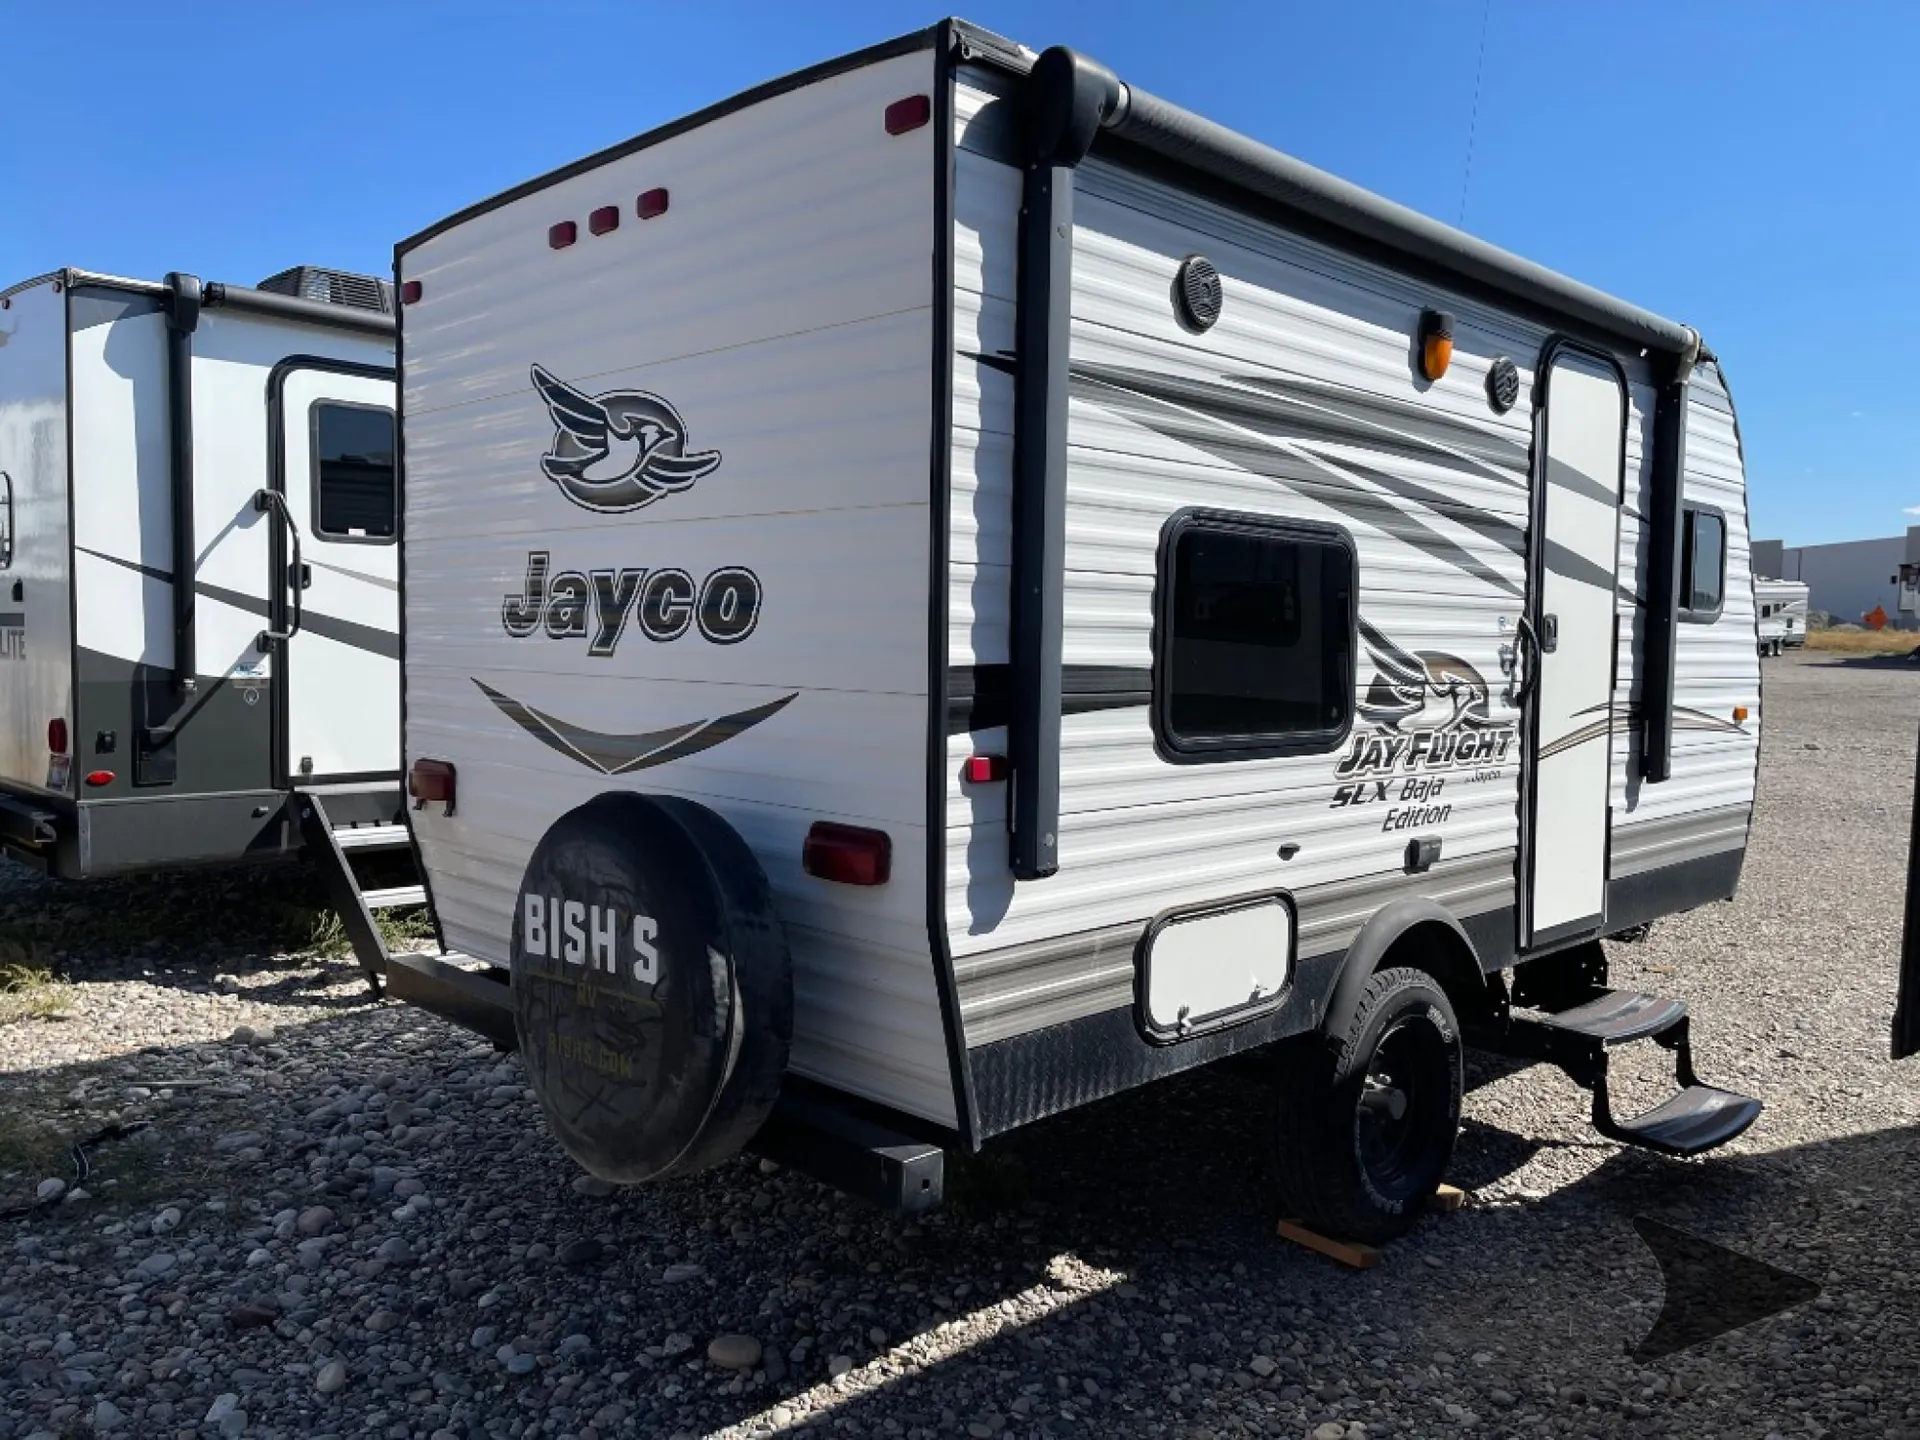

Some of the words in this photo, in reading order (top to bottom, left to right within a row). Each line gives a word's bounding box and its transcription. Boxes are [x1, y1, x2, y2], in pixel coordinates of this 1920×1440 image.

[502, 551, 762, 656] Jayco
[1329, 780, 1394, 808] SLX
[1400, 776, 1445, 803] Baja
[1382, 804, 1453, 832] Edition
[577, 982, 597, 1008] RV
